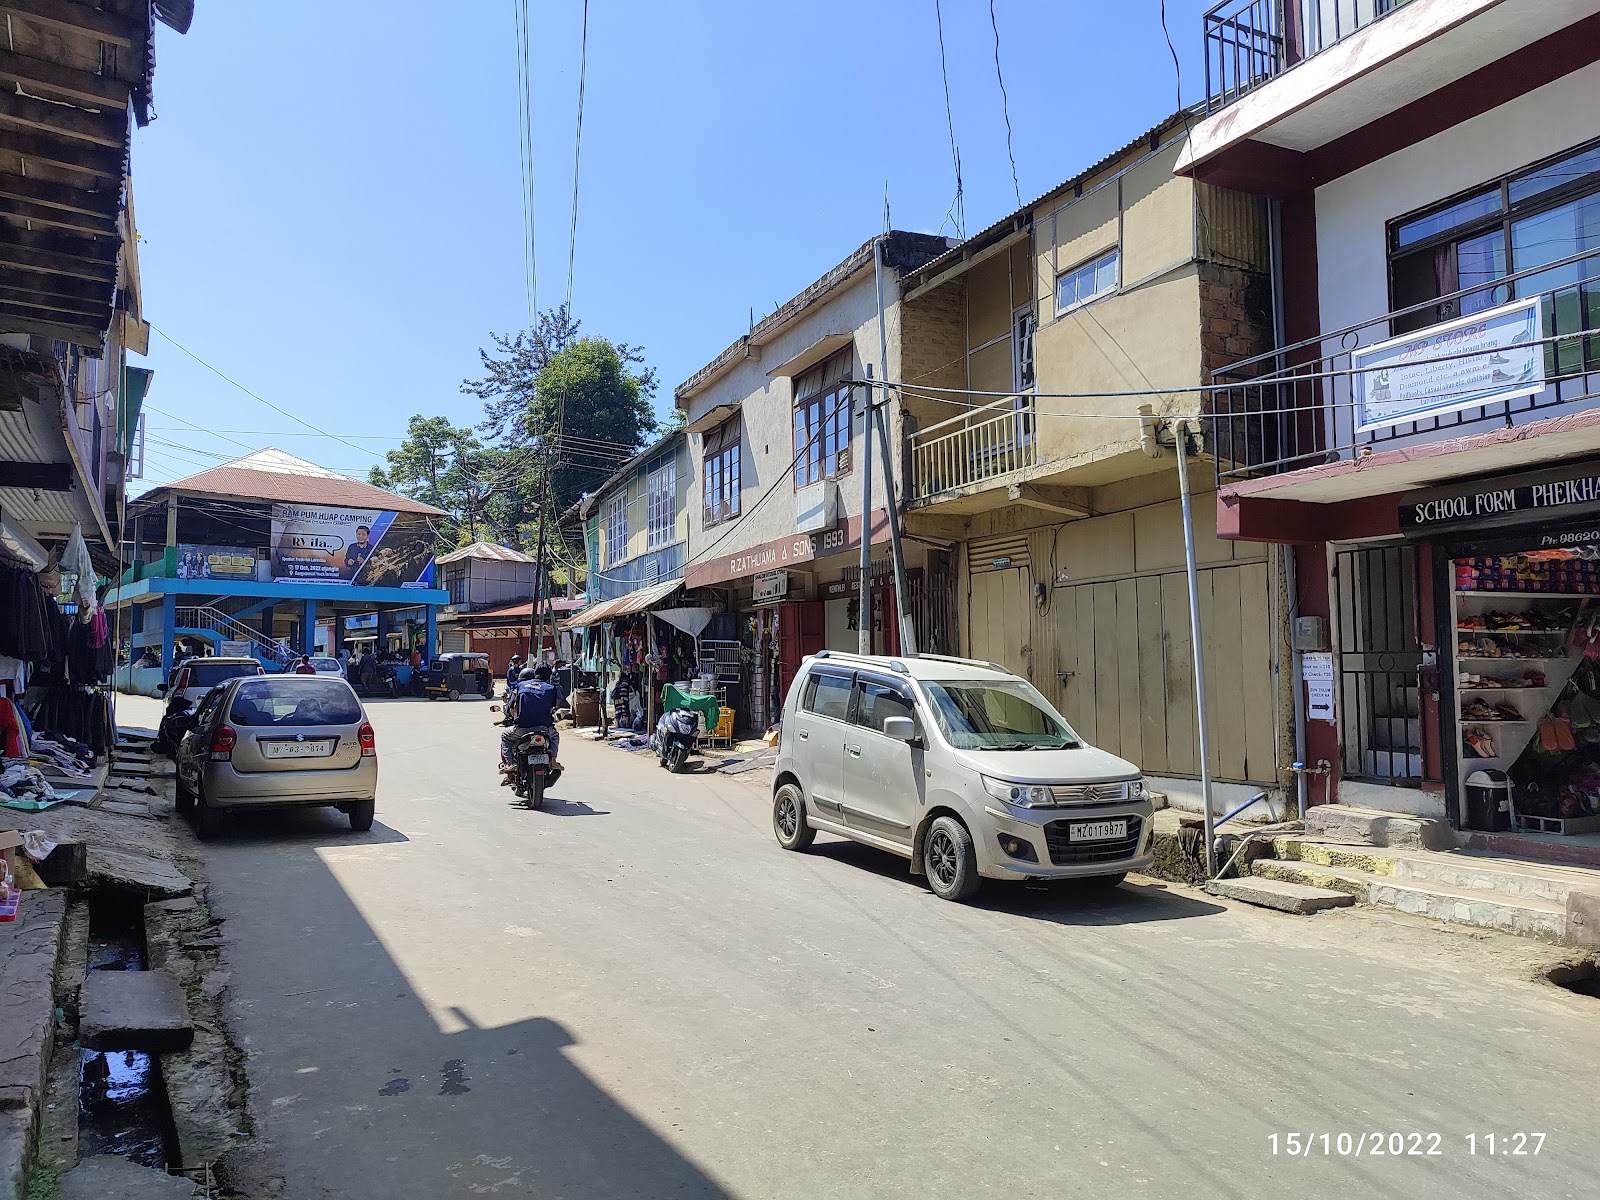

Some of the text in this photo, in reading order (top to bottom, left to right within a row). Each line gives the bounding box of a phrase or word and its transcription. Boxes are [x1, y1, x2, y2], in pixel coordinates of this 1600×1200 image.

[1415, 496, 1473, 523] SCHOOL
[1475, 488, 1517, 515] FORM
[282, 508, 299, 518] RAM
[300, 510, 317, 520] PUM
[318, 512, 339, 521] HUAP
[339, 513, 372, 524] CAMPING
[1560, 530, 1600, 544] 98620
[730, 529, 844, 574] R.ZATHUAMA & SONS 1993
[1077, 823, 1123, 838] MZ01T9877
